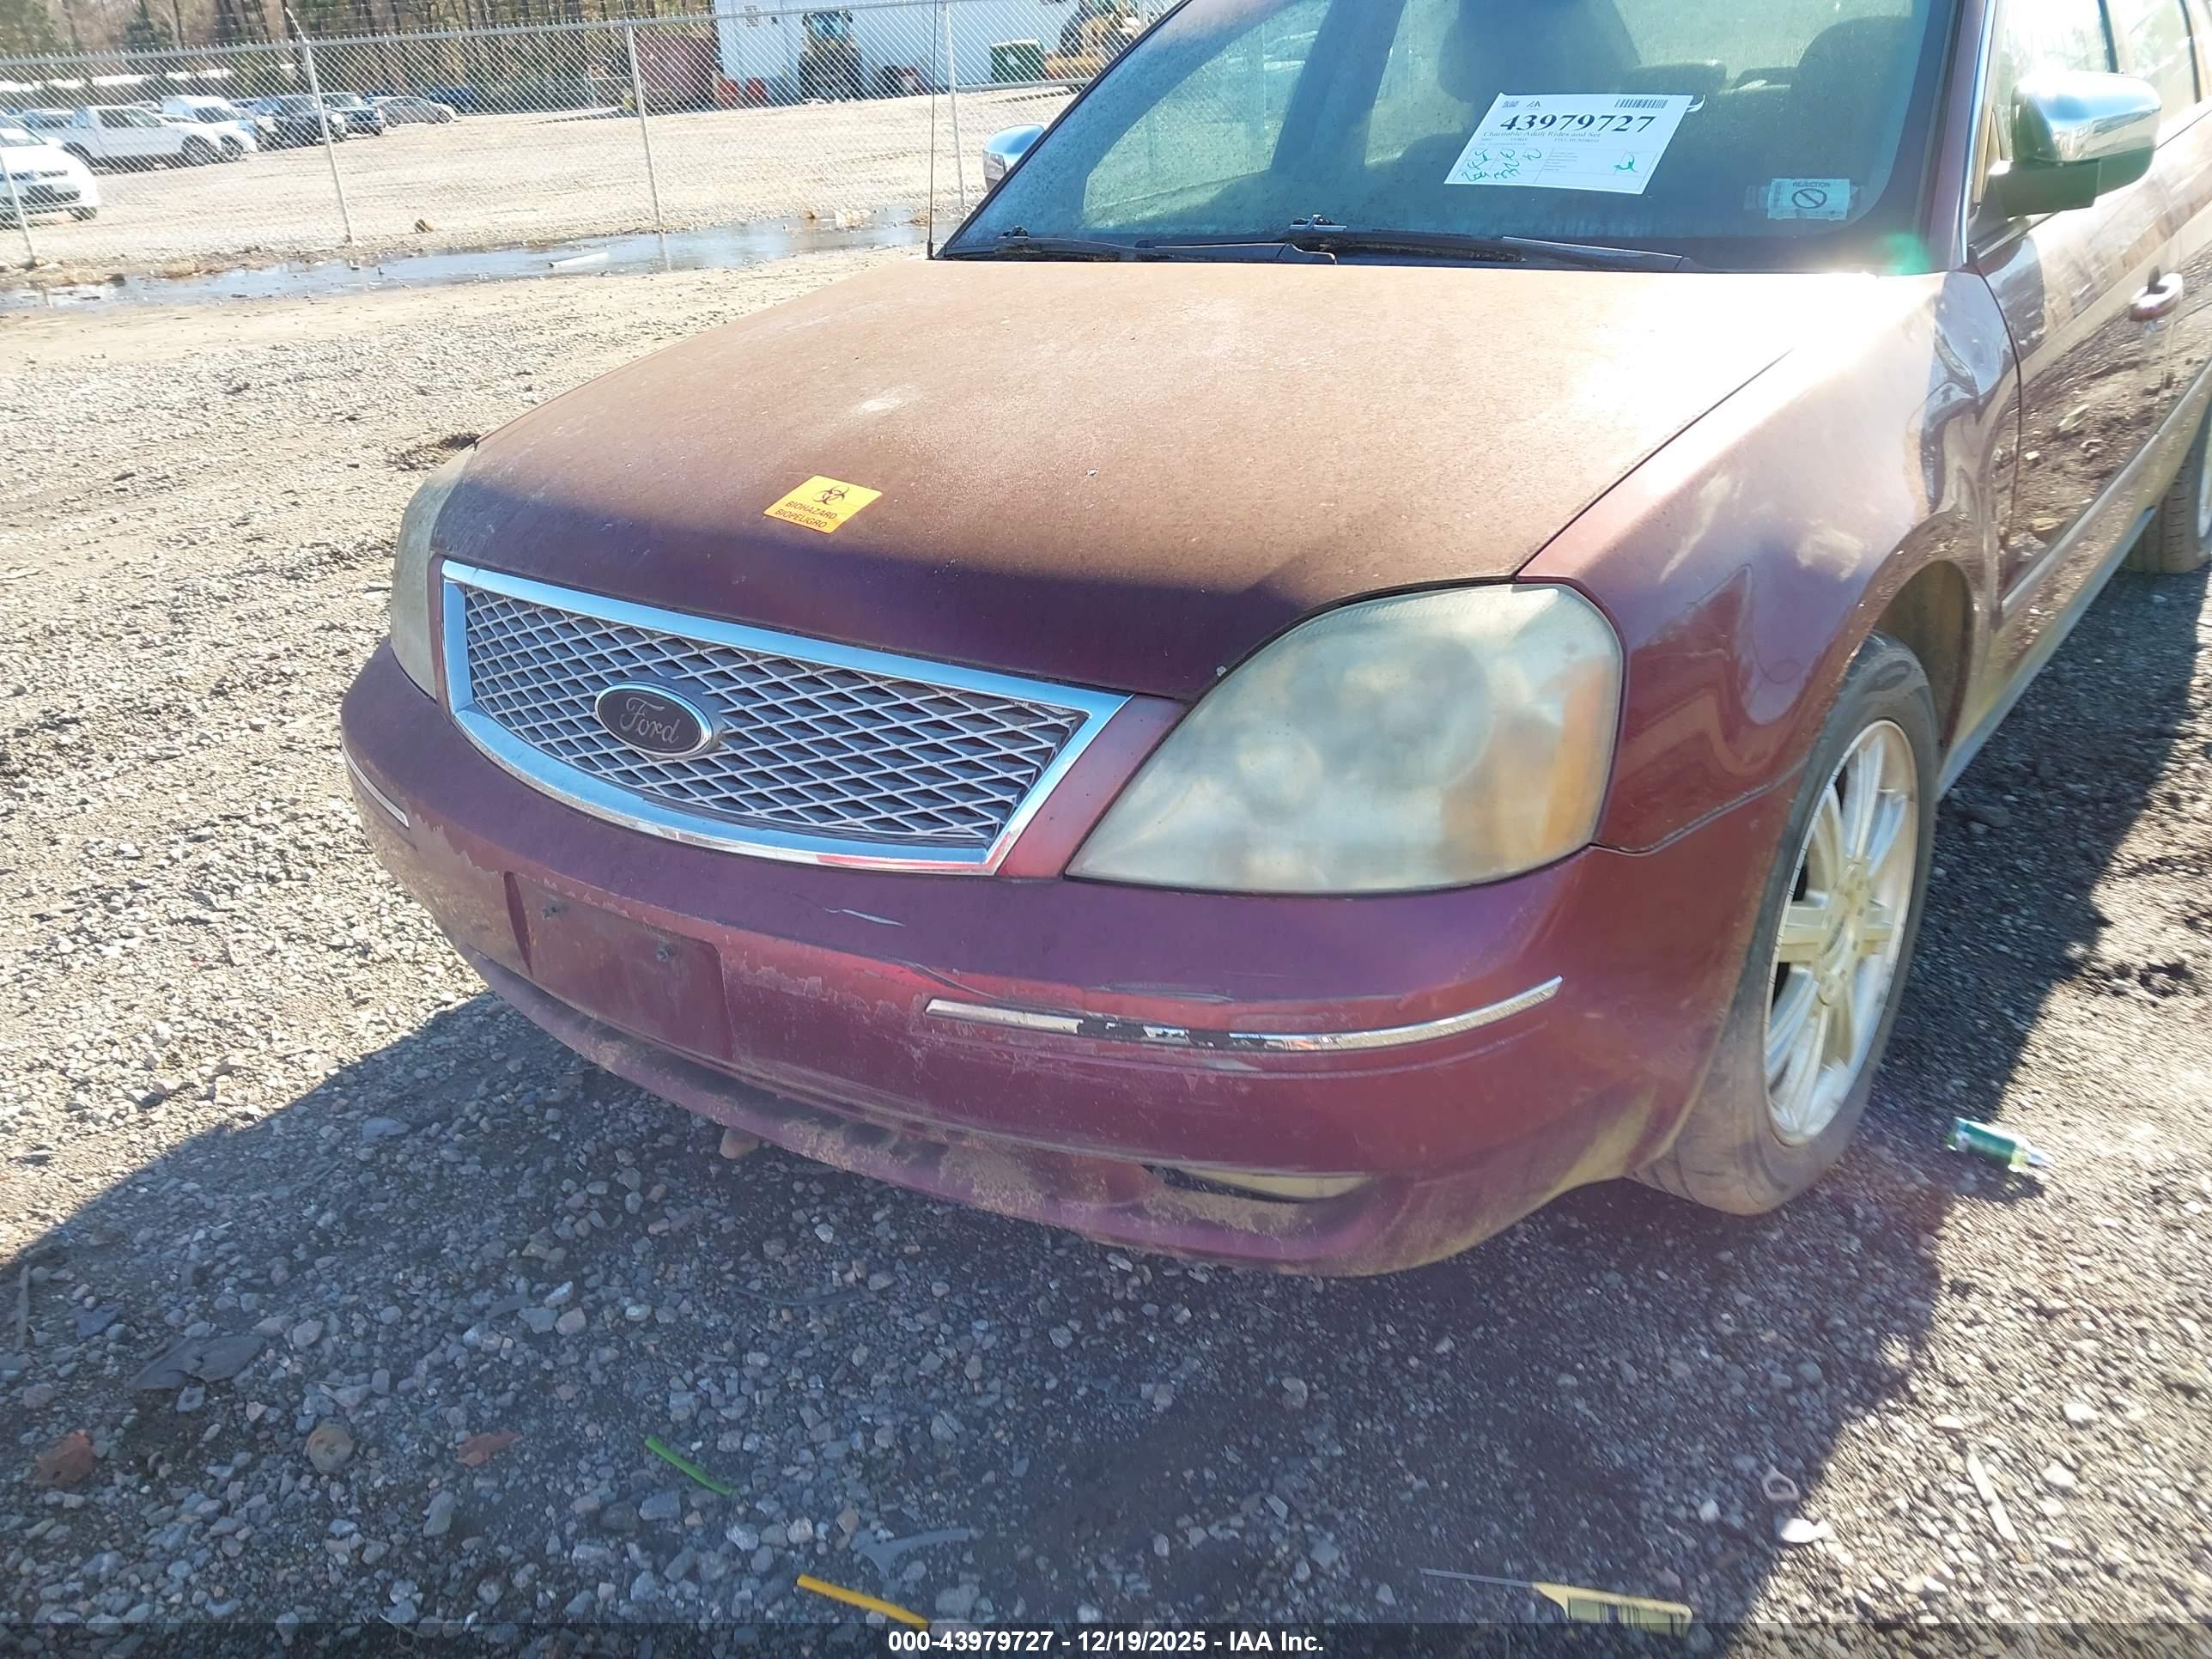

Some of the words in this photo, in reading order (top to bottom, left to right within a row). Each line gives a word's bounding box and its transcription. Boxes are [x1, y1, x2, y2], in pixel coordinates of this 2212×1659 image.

[1499, 114, 1656, 133] 43979727
[775, 508, 828, 528] BIOPELIGRO
[785, 501, 838, 520] BIOHAZARD
[619, 696, 681, 744] Ford
